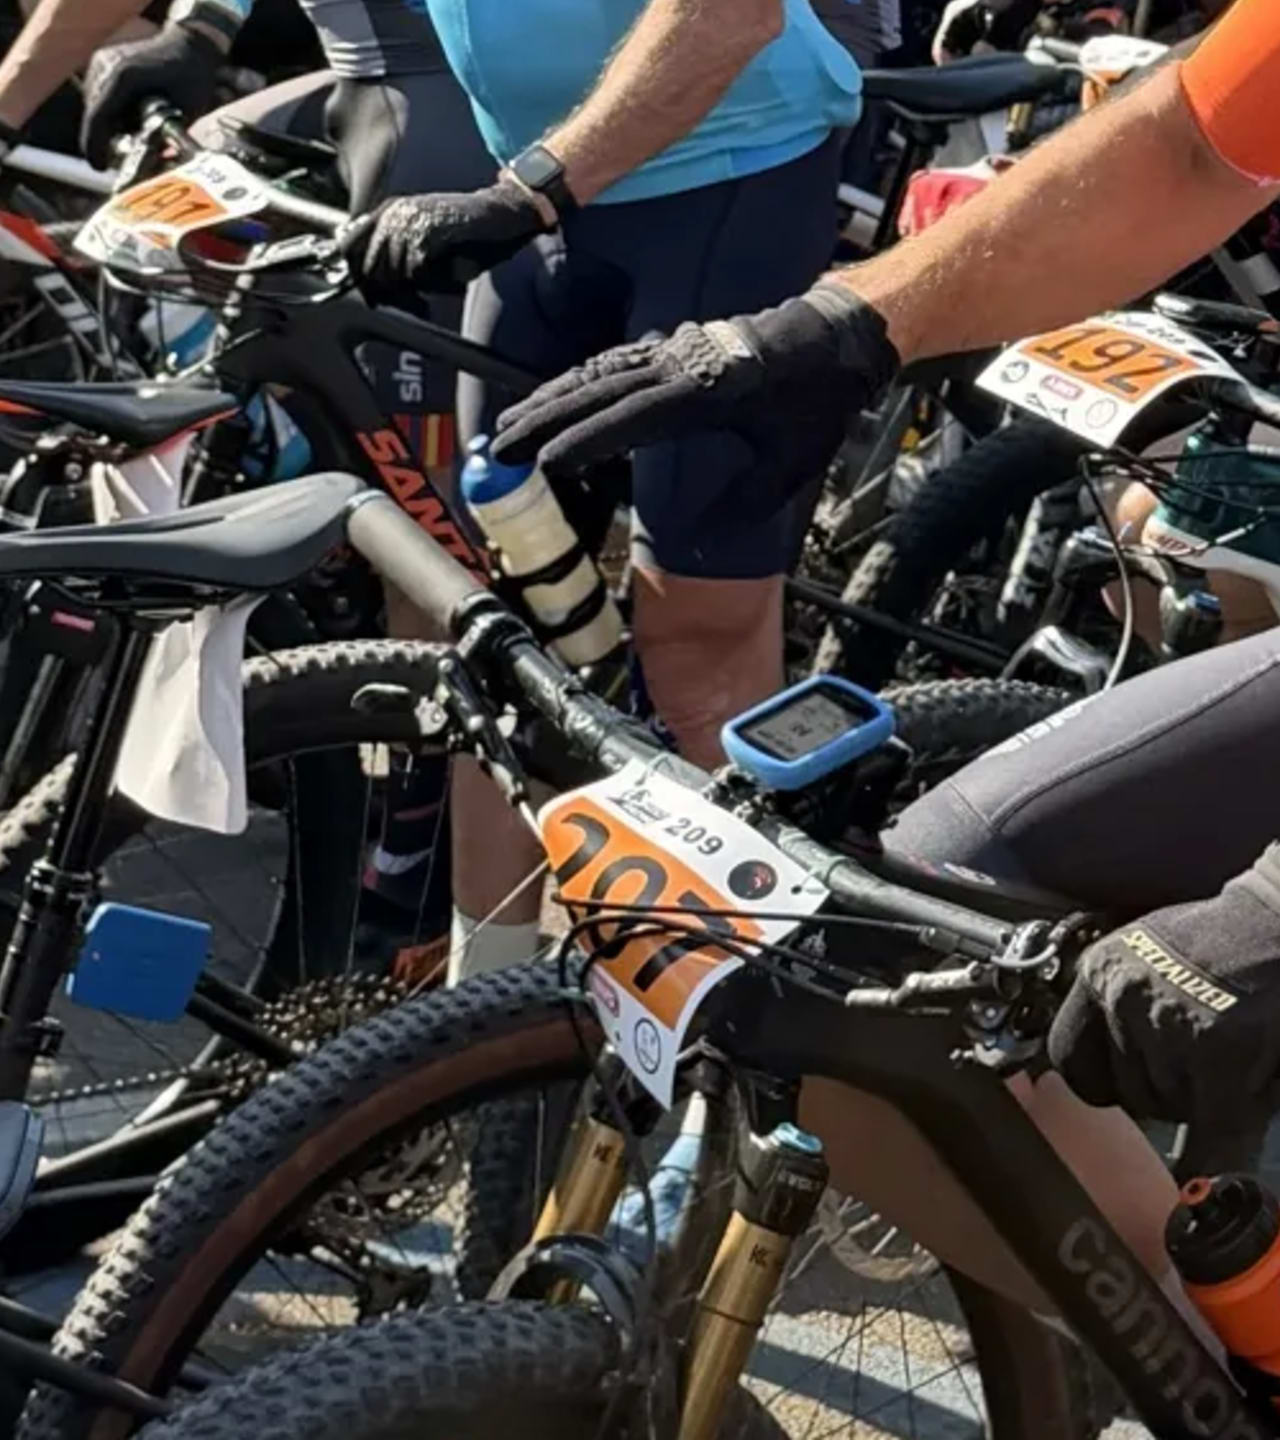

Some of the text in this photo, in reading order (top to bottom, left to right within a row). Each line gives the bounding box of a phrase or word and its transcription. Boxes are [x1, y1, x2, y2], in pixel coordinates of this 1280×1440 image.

[664, 816, 724, 856] 209
[1121, 930, 1238, 1012] SPECIALIZED
[1057, 1216, 1265, 1440] Canno
